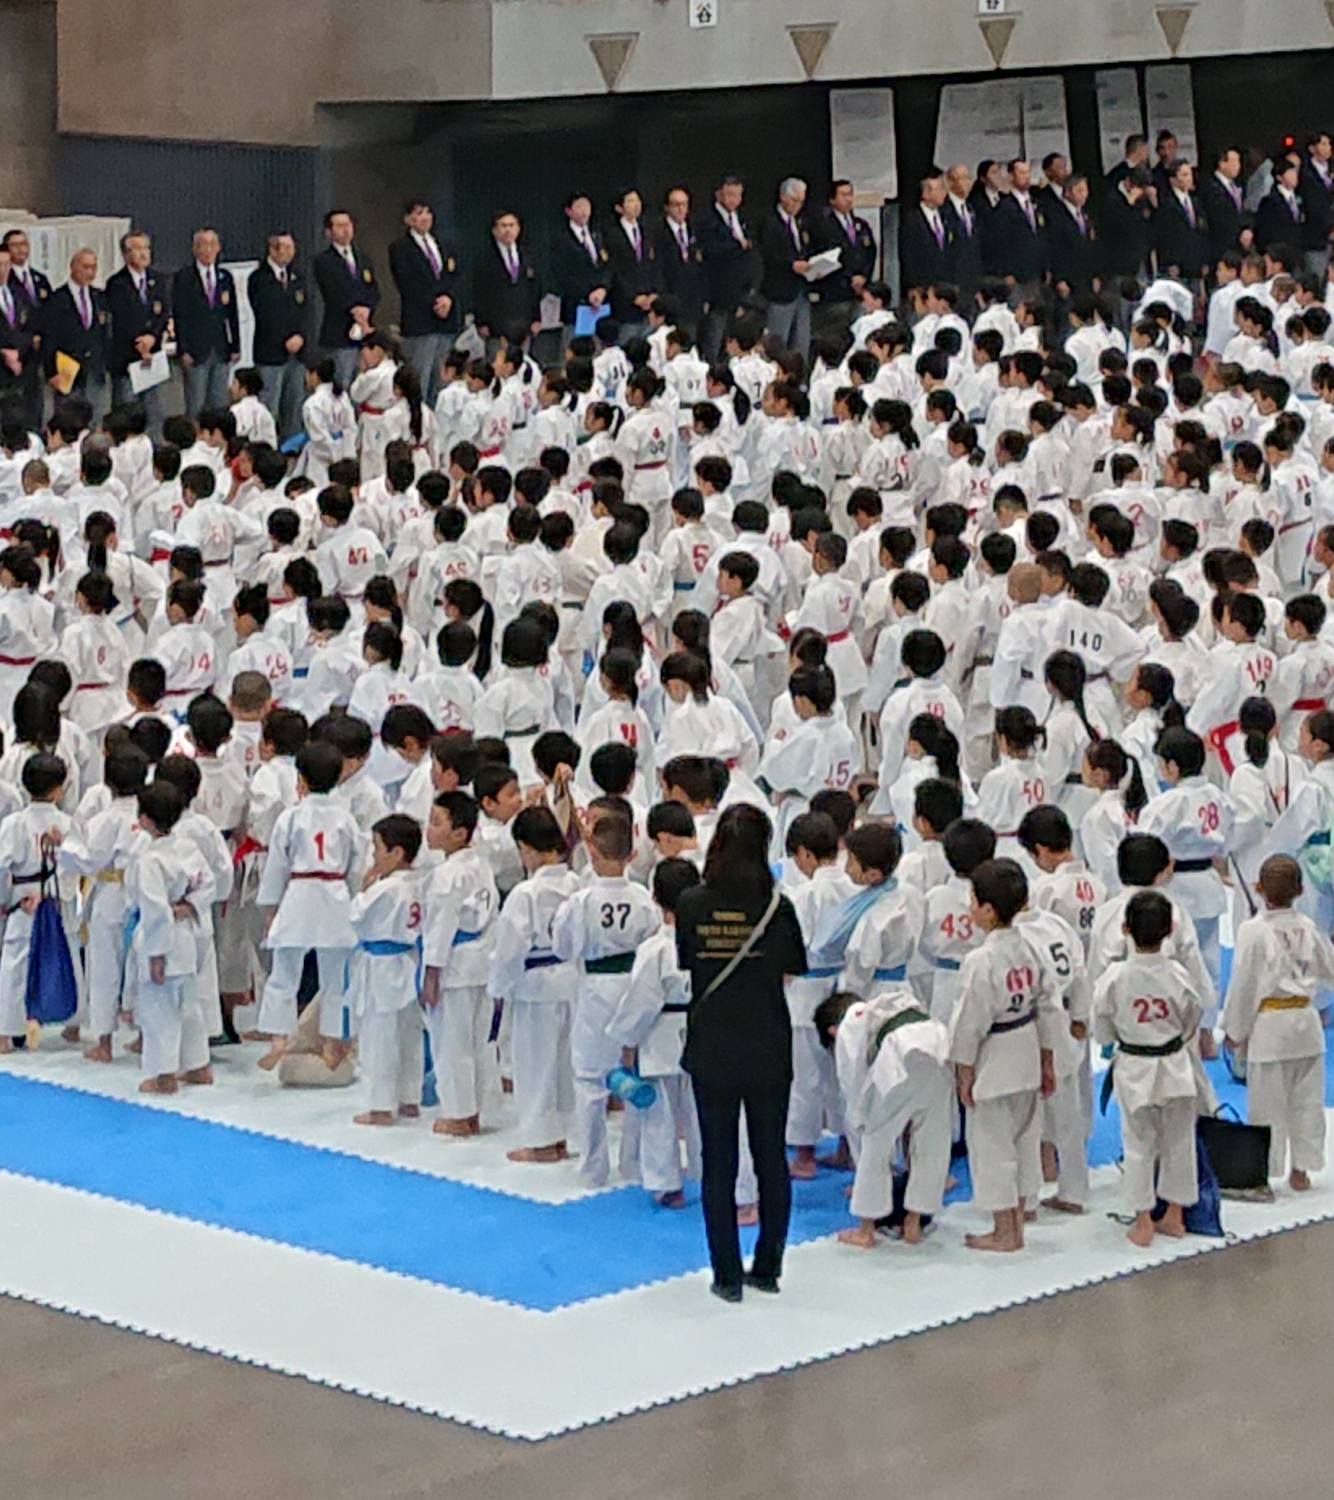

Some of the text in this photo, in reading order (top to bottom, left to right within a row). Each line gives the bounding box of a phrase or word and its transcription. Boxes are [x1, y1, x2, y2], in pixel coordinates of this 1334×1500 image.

[692, 543, 710, 574] 5
[1070, 629, 1102, 652] 140
[1023, 780, 1044, 804] 50
[1197, 801, 1219, 835] 28
[313, 830, 324, 862] 1
[1075, 880, 1094, 903] 40
[406, 900, 422, 929] 3
[601, 902, 631, 931] 37
[940, 913, 973, 941] 43
[1049, 942, 1069, 976] 5
[1132, 998, 1170, 1023] 23
